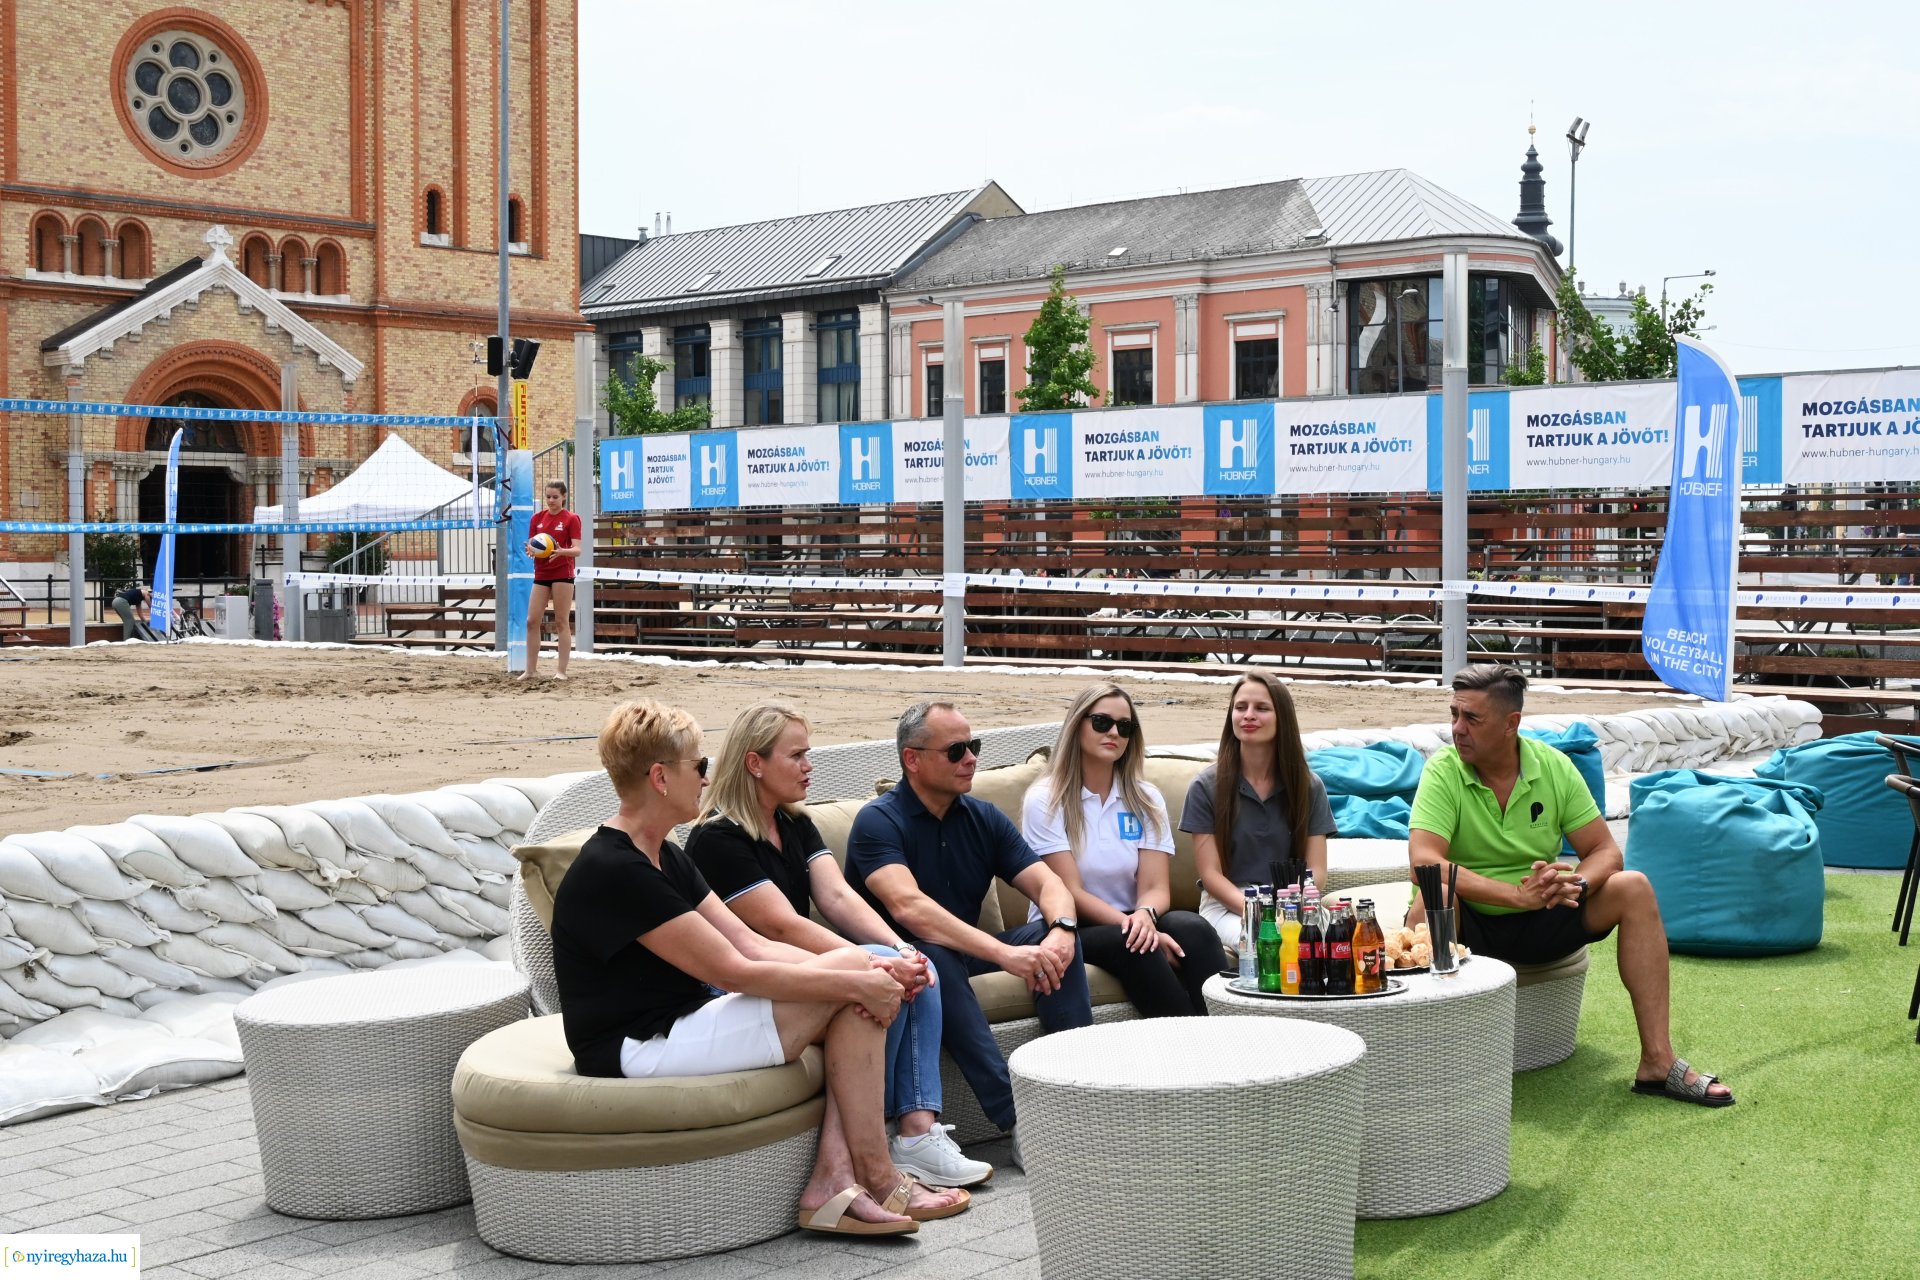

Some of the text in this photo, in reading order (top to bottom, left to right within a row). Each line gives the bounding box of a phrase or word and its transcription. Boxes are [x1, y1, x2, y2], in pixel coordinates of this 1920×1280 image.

[1802, 396, 1920, 417] MOZGÁSBAN
[1526, 409, 1626, 428] MOZGÁSBAN
[1290, 420, 1376, 437] MOZGÁSBAN
[1801, 421, 1882, 438] TARTJUK
[1886, 421, 1899, 436] A
[904, 438, 970, 452] MOZGÁN
[1085, 429, 1159, 445] MOZGÁSBAN
[1526, 427, 1669, 447] TARTJUK A JÖVŐT!
[747, 445, 805, 459] MOZGÁSBAN
[1289, 437, 1412, 455] TARTJUK A JÖVŐT!
[1801, 444, 1920, 458] www.hubner-hungary.h
[904, 452, 998, 468] TARTJU ÖVŐT!
[1085, 449, 1134, 462] TARTJUK
[1136, 448, 1145, 461] A
[1526, 454, 1631, 467] www.hubner-hungary.hu
[647, 465, 674, 474] TARTJUK
[747, 462, 786, 475] TARTJUK
[788, 462, 795, 473] A
[1085, 468, 1164, 479] www.hubner-hungary.hu
[1289, 462, 1380, 473] www.hubner-hungary.hu
[1467, 464, 1490, 475] NER
[1667, 628, 1708, 645] BEACH
[1645, 635, 1724, 666] VOLLEYBALL
[1650, 651, 1722, 679] IN THE CITY
